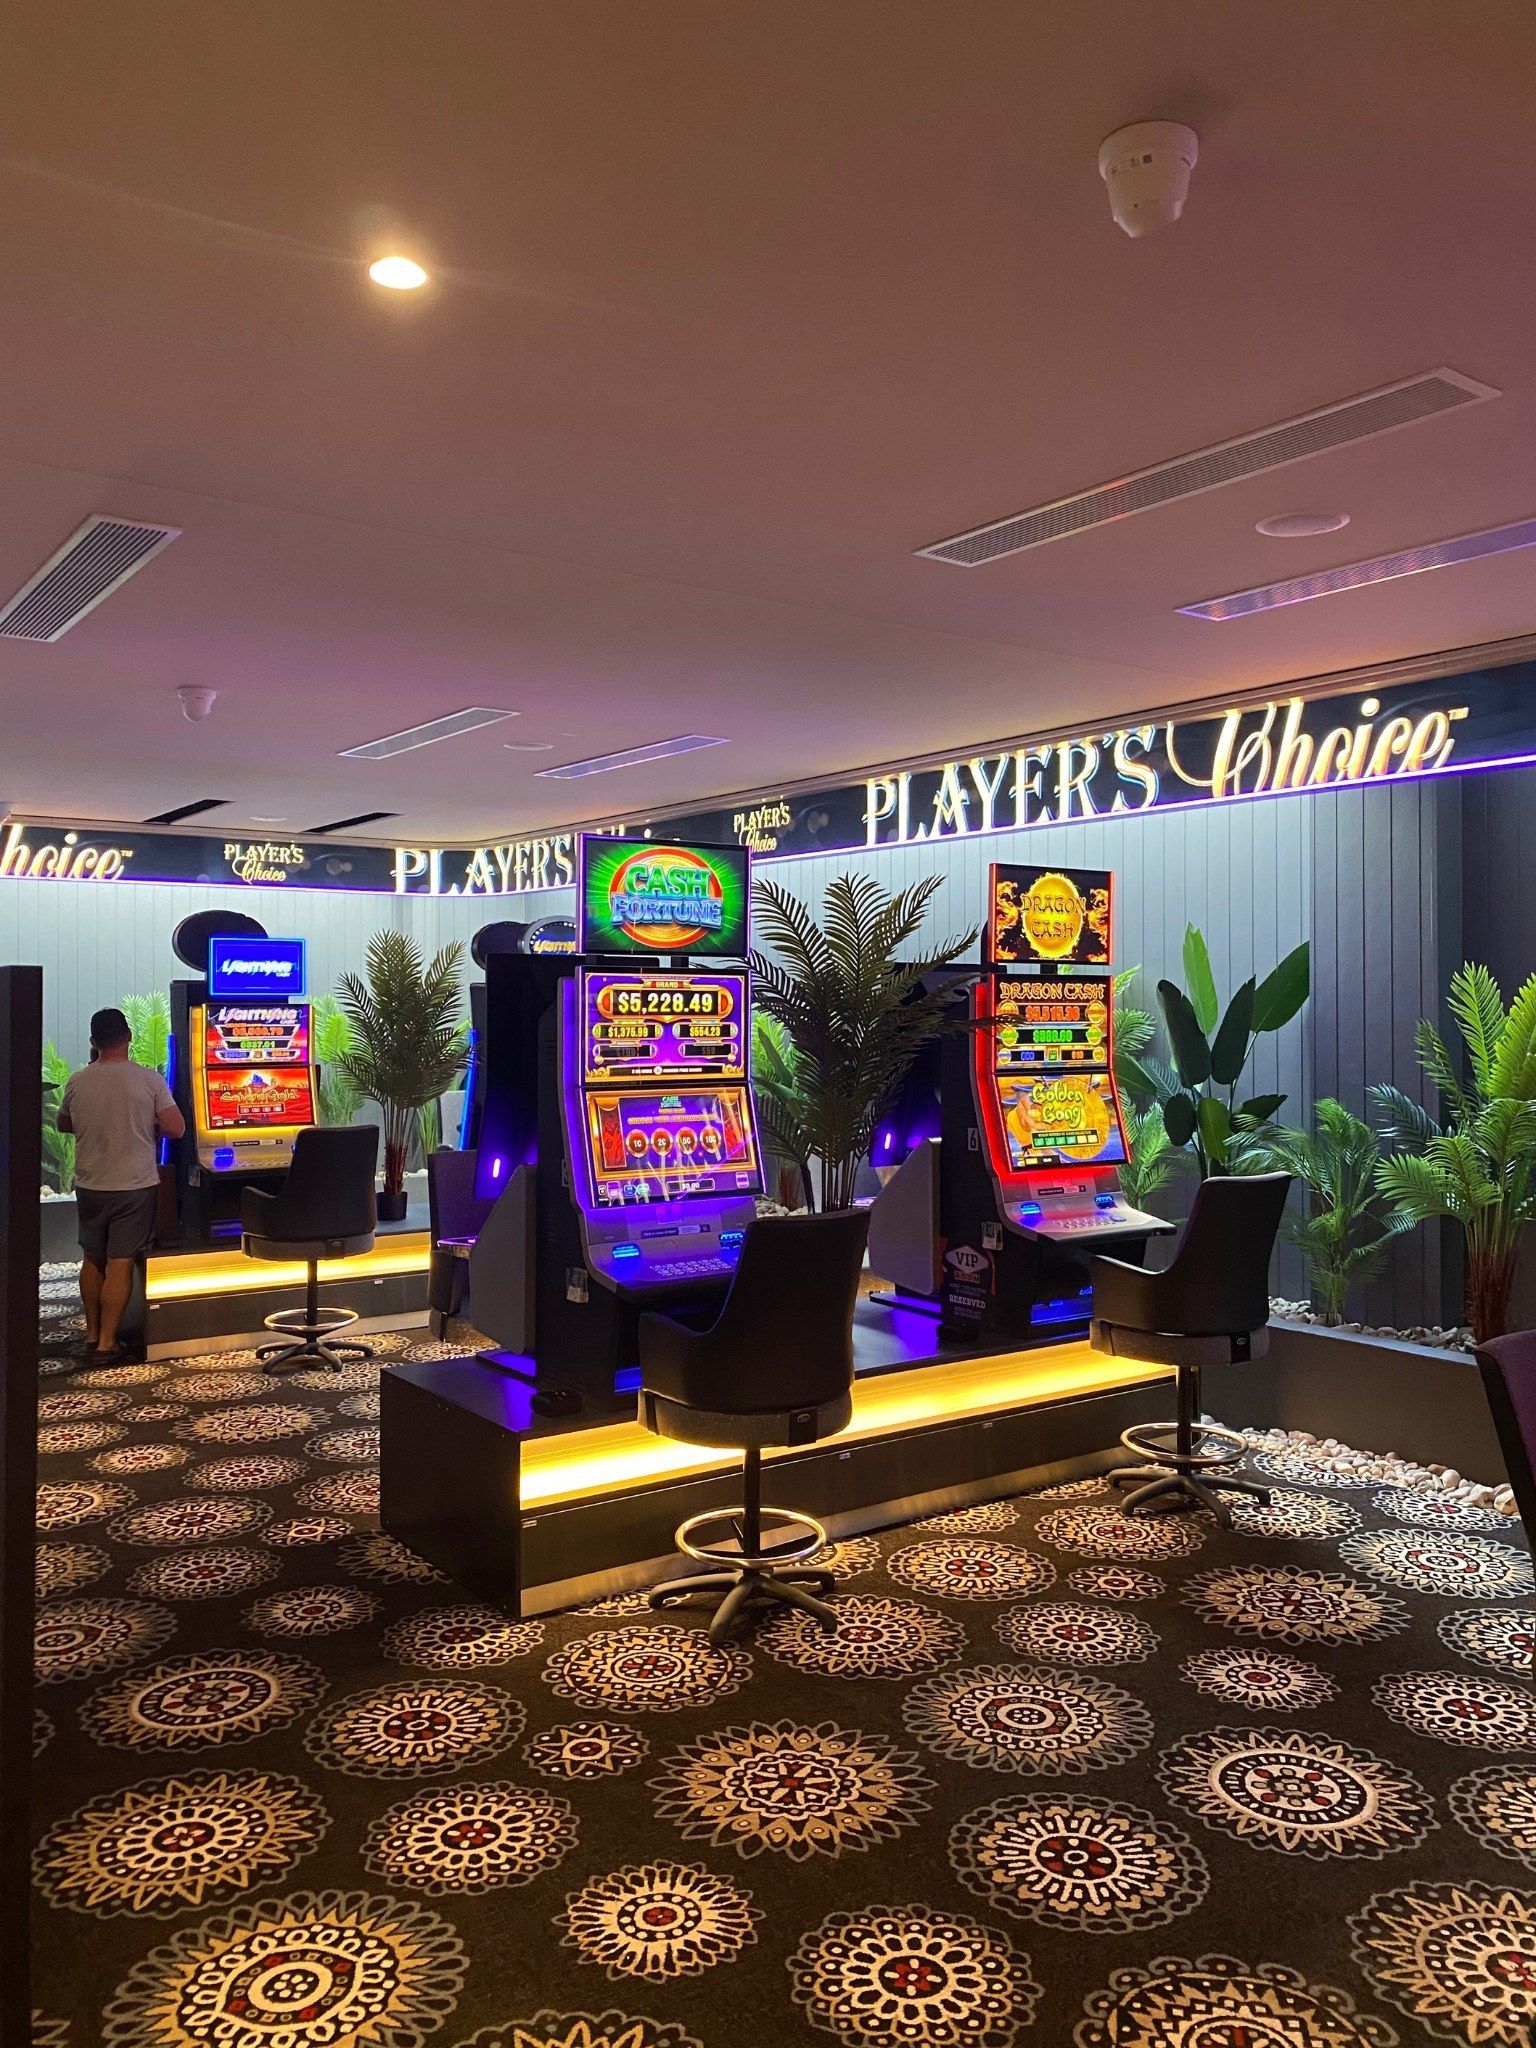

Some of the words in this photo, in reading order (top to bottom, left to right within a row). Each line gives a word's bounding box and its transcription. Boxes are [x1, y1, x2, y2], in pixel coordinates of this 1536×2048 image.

[862, 722, 1159, 846] PLAYER'S
[1166, 695, 1455, 798] Choice
[733, 801, 791, 833] PLAYER'S
[0, 822, 124, 880] hoice
[223, 842, 304, 864] PLAYER'S
[232, 858, 286, 884] Choice
[390, 833, 573, 896] PLAYER'S
[625, 863, 711, 899] CASH
[610, 892, 723, 929] FORTUNE
[1020, 893, 1087, 916] DRAGON
[1030, 920, 1075, 940] CASH
[618, 991, 713, 1015] $5,228.49
[999, 982, 1063, 1000] DRAGON
[1063, 983, 1105, 1001] CASH
[217, 1006, 299, 1024] LIGHTNING
[1032, 1082, 1085, 1106] Golden
[1041, 1102, 1084, 1129] Gong
[955, 1251, 979, 1268] VIP
[949, 1294, 986, 1310] RESERVED
